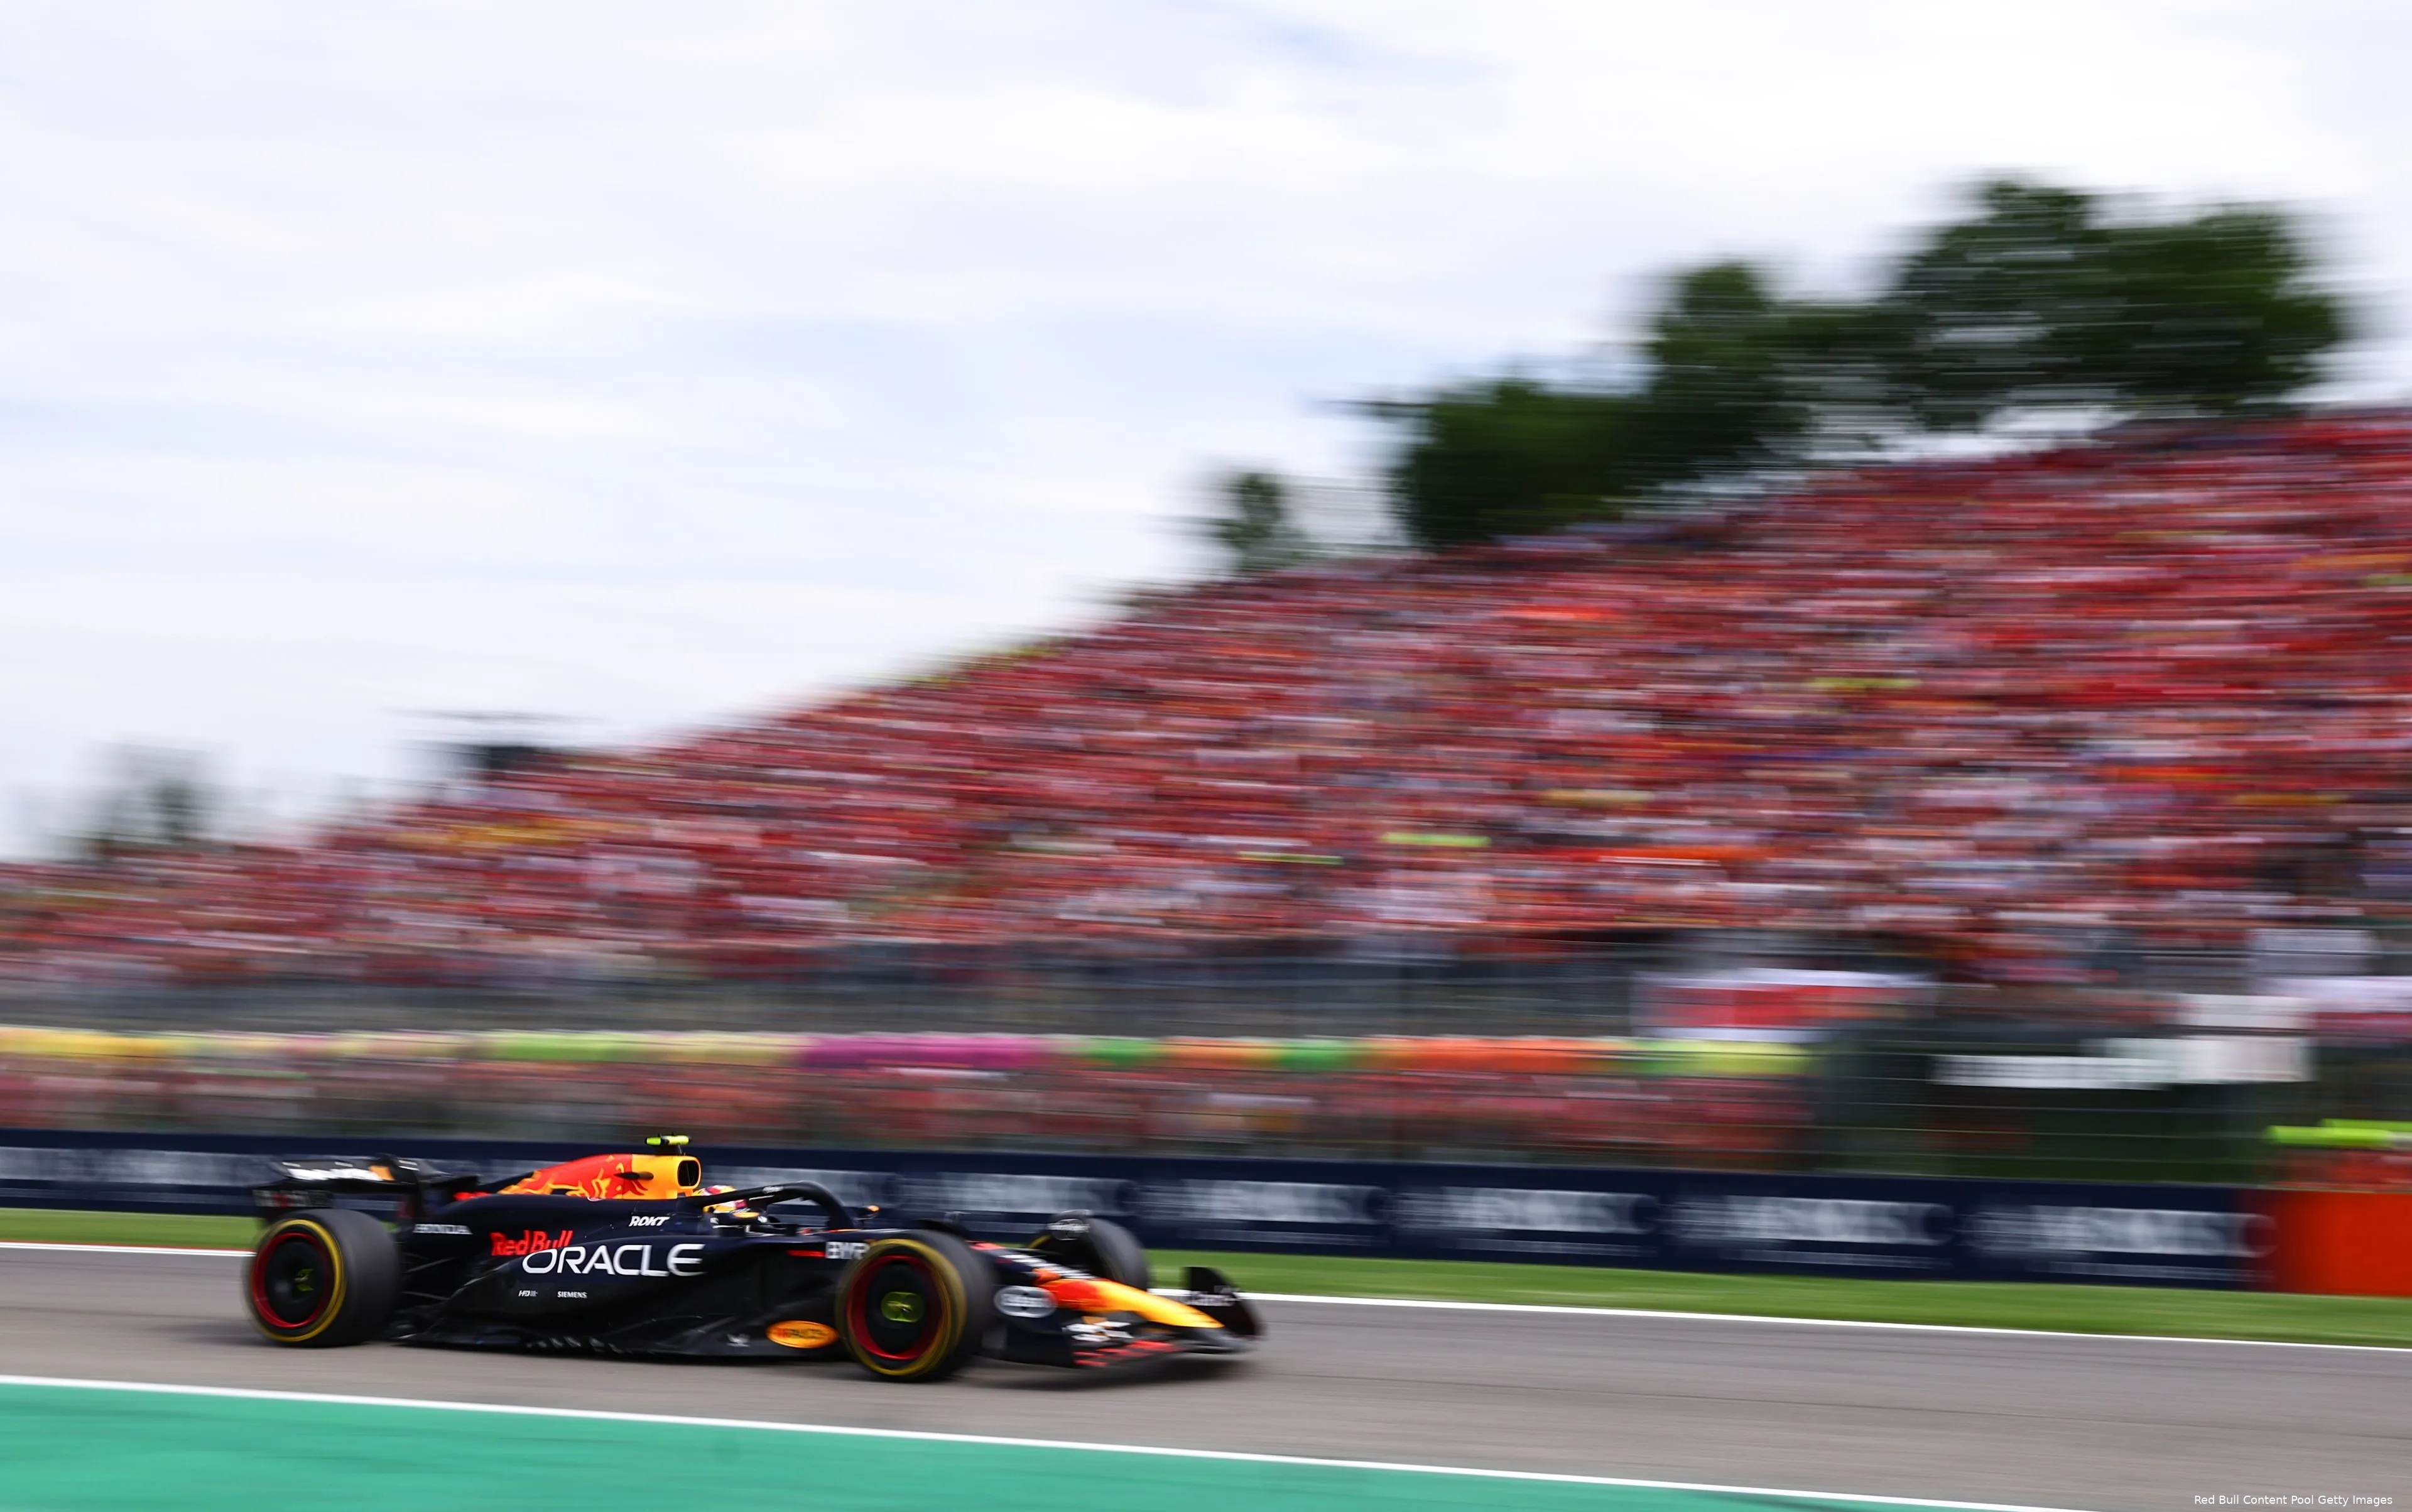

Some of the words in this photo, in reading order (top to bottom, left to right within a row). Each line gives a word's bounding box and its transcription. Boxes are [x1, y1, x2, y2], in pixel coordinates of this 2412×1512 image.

[629, 1216, 670, 1227] ROKT
[489, 1229, 531, 1256] Red
[529, 1230, 573, 1254] Bull
[522, 1243, 707, 1276] ORACLE
